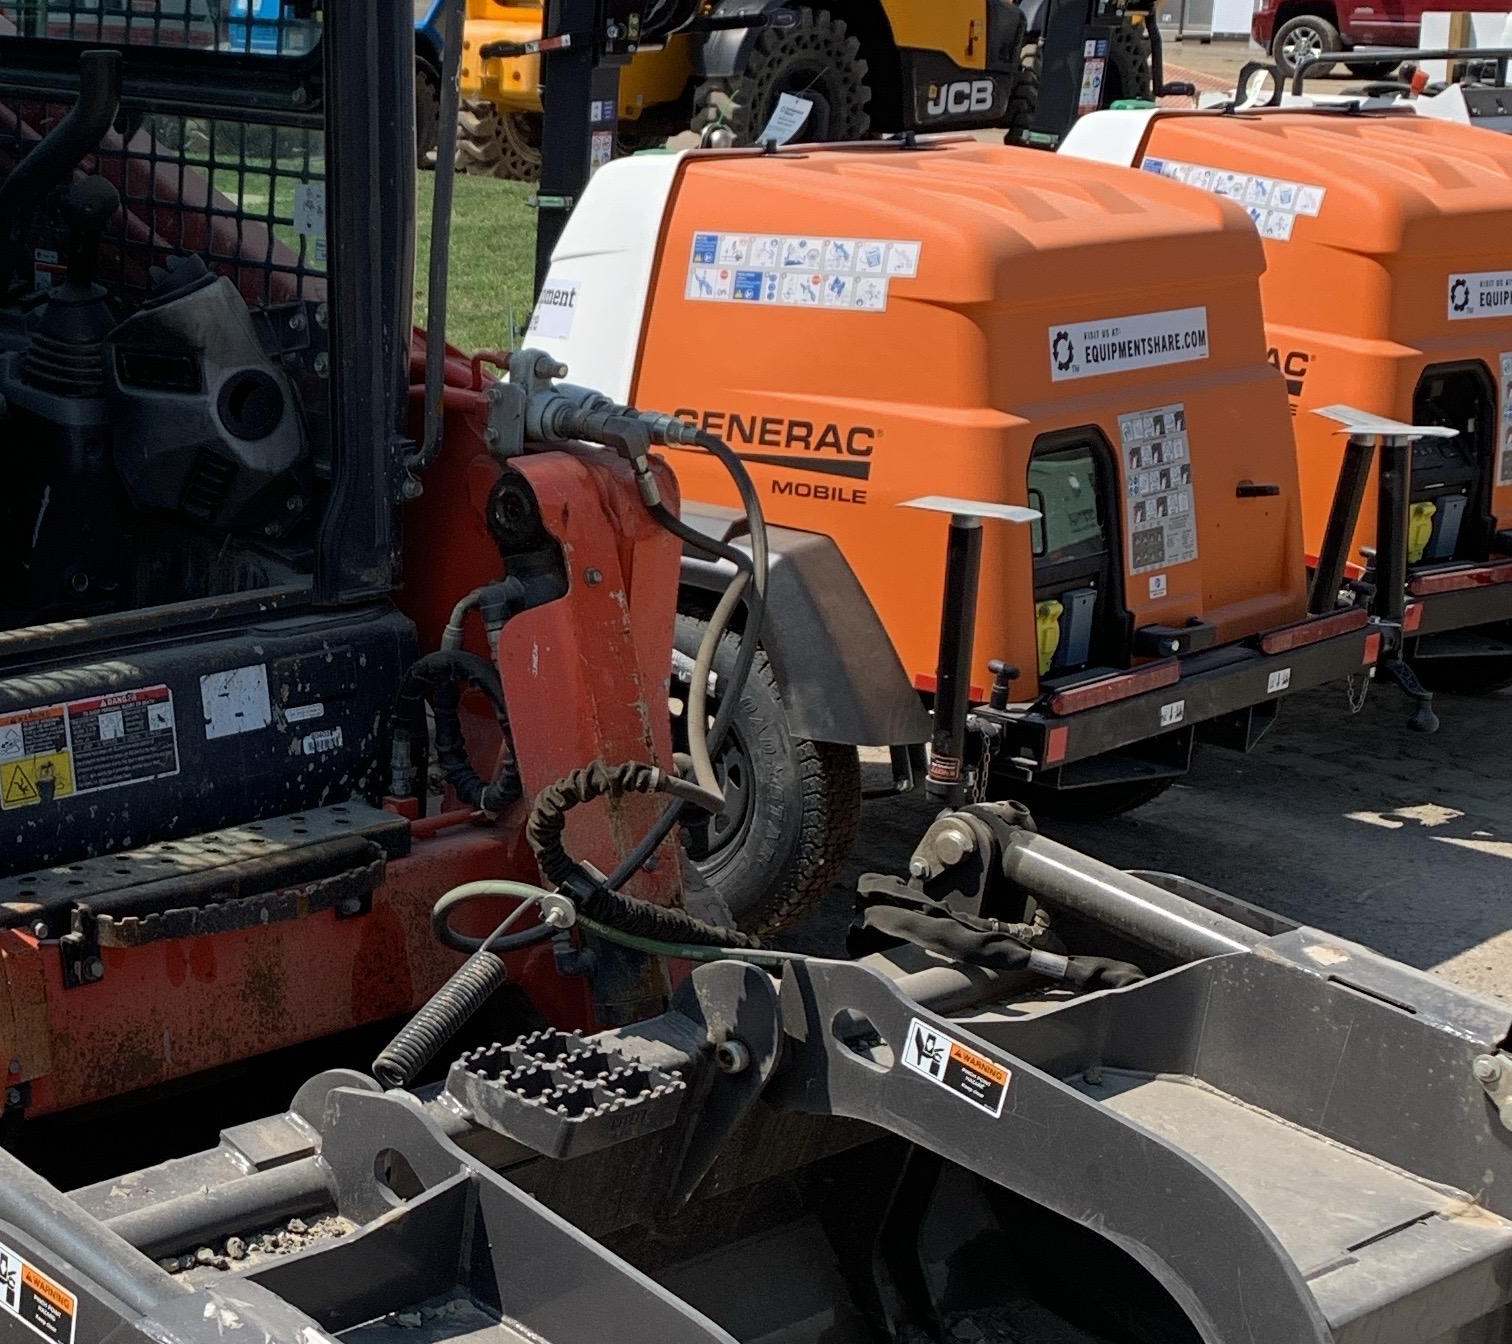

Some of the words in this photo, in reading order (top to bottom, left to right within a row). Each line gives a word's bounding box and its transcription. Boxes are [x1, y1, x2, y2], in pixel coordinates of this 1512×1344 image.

[927, 80, 994, 115] JCB
[1083, 329, 1100, 341] VISIT
[1102, 328, 1110, 338] US
[1085, 329, 1206, 364] EQUIPMENTSHARE.COM
[674, 408, 875, 456] GENERAC
[772, 480, 867, 504] MOBILE
[962, 1054, 1002, 1080] WARNING
[33, 1279, 70, 1309] WARNING
